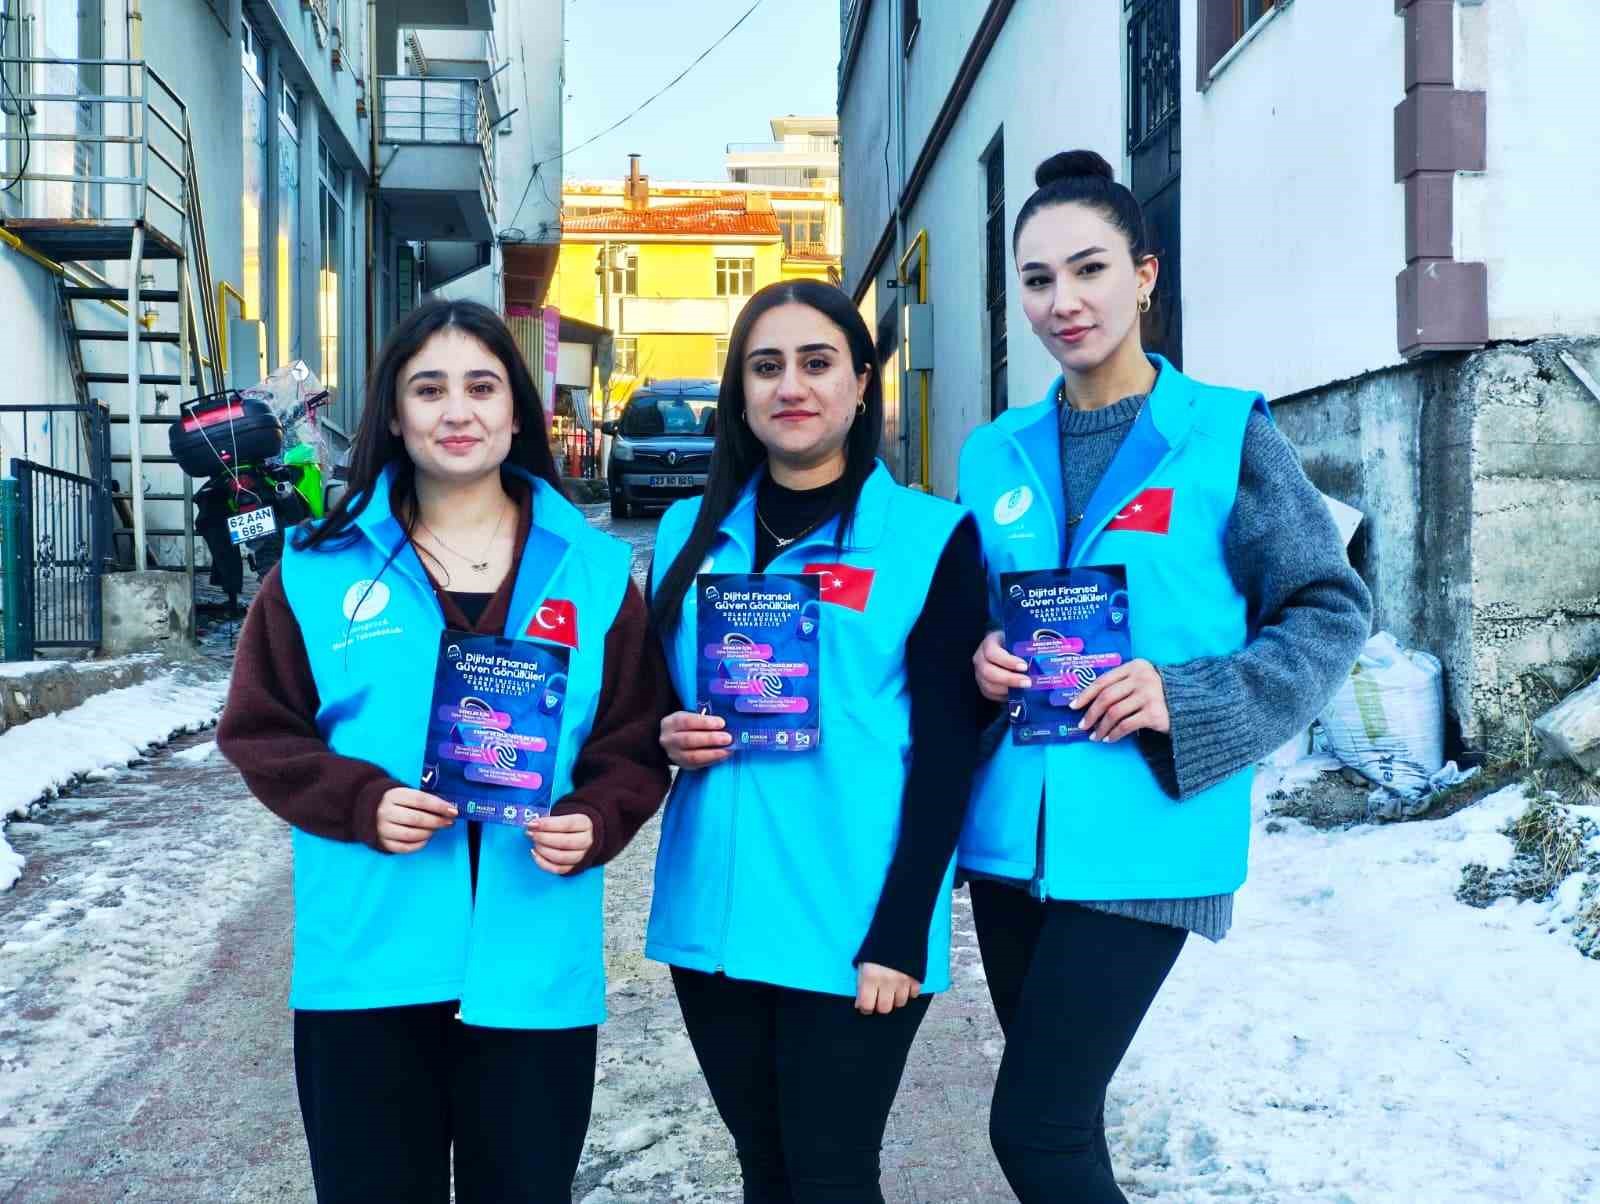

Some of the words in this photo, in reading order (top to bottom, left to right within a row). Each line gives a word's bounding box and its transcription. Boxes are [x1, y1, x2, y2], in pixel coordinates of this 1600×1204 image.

[230, 516, 245, 528] 62
[247, 508, 271, 523] AAN
[242, 522, 264, 537] 685
[723, 592, 750, 601] Dijital
[752, 592, 791, 600] Finansal
[1028, 587, 1056, 599] Dijital
[1058, 584, 1098, 595] Finansal
[714, 601, 747, 609] Güven
[749, 601, 800, 610] Gönüllüleri
[1021, 599, 1054, 607] Güven
[1056, 592, 1108, 604] Gönüllüleri
[466, 653, 495, 664] Dijital
[496, 657, 537, 671] Finansal
[456, 662, 490, 674] Güven
[492, 666, 546, 682] Gönüllüleri
